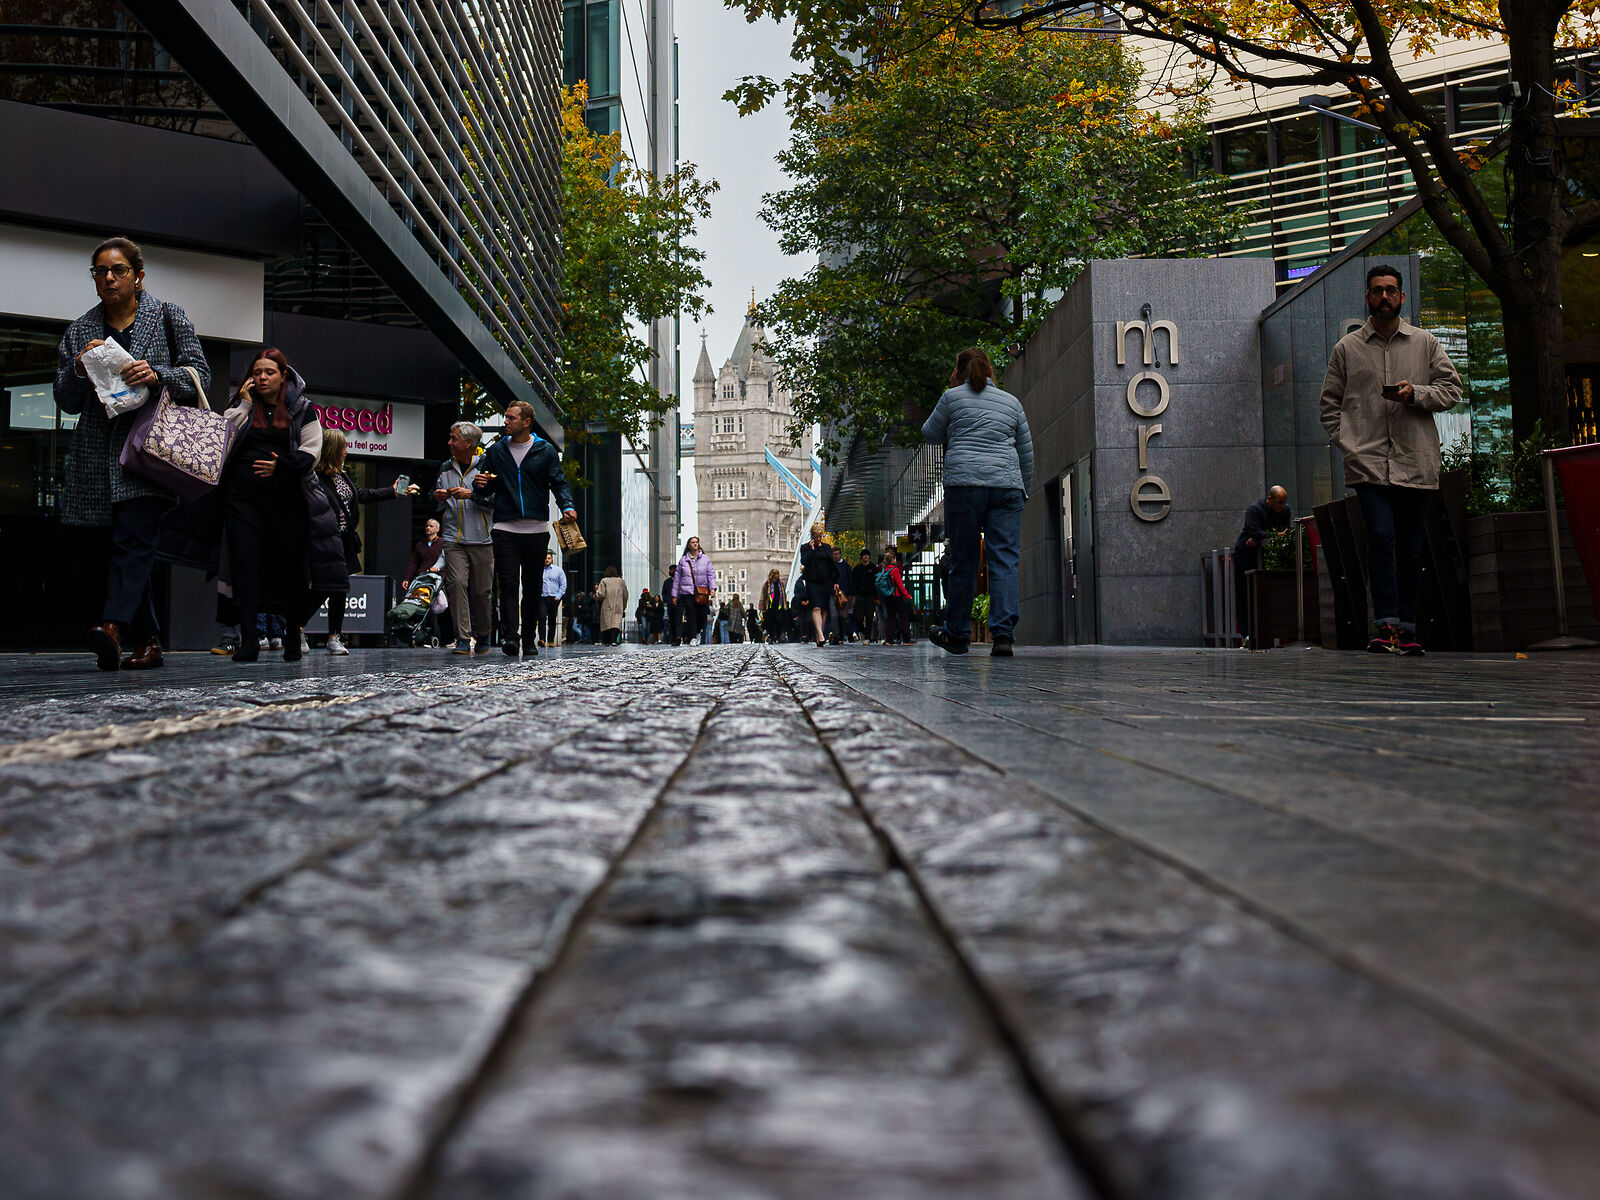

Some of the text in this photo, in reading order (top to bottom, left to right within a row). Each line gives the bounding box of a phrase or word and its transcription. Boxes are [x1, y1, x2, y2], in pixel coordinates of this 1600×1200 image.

[312, 402, 393, 435] ossed
[1116, 320, 1179, 522] more
[354, 440, 367, 449] feel
[369, 443, 387, 452] good
